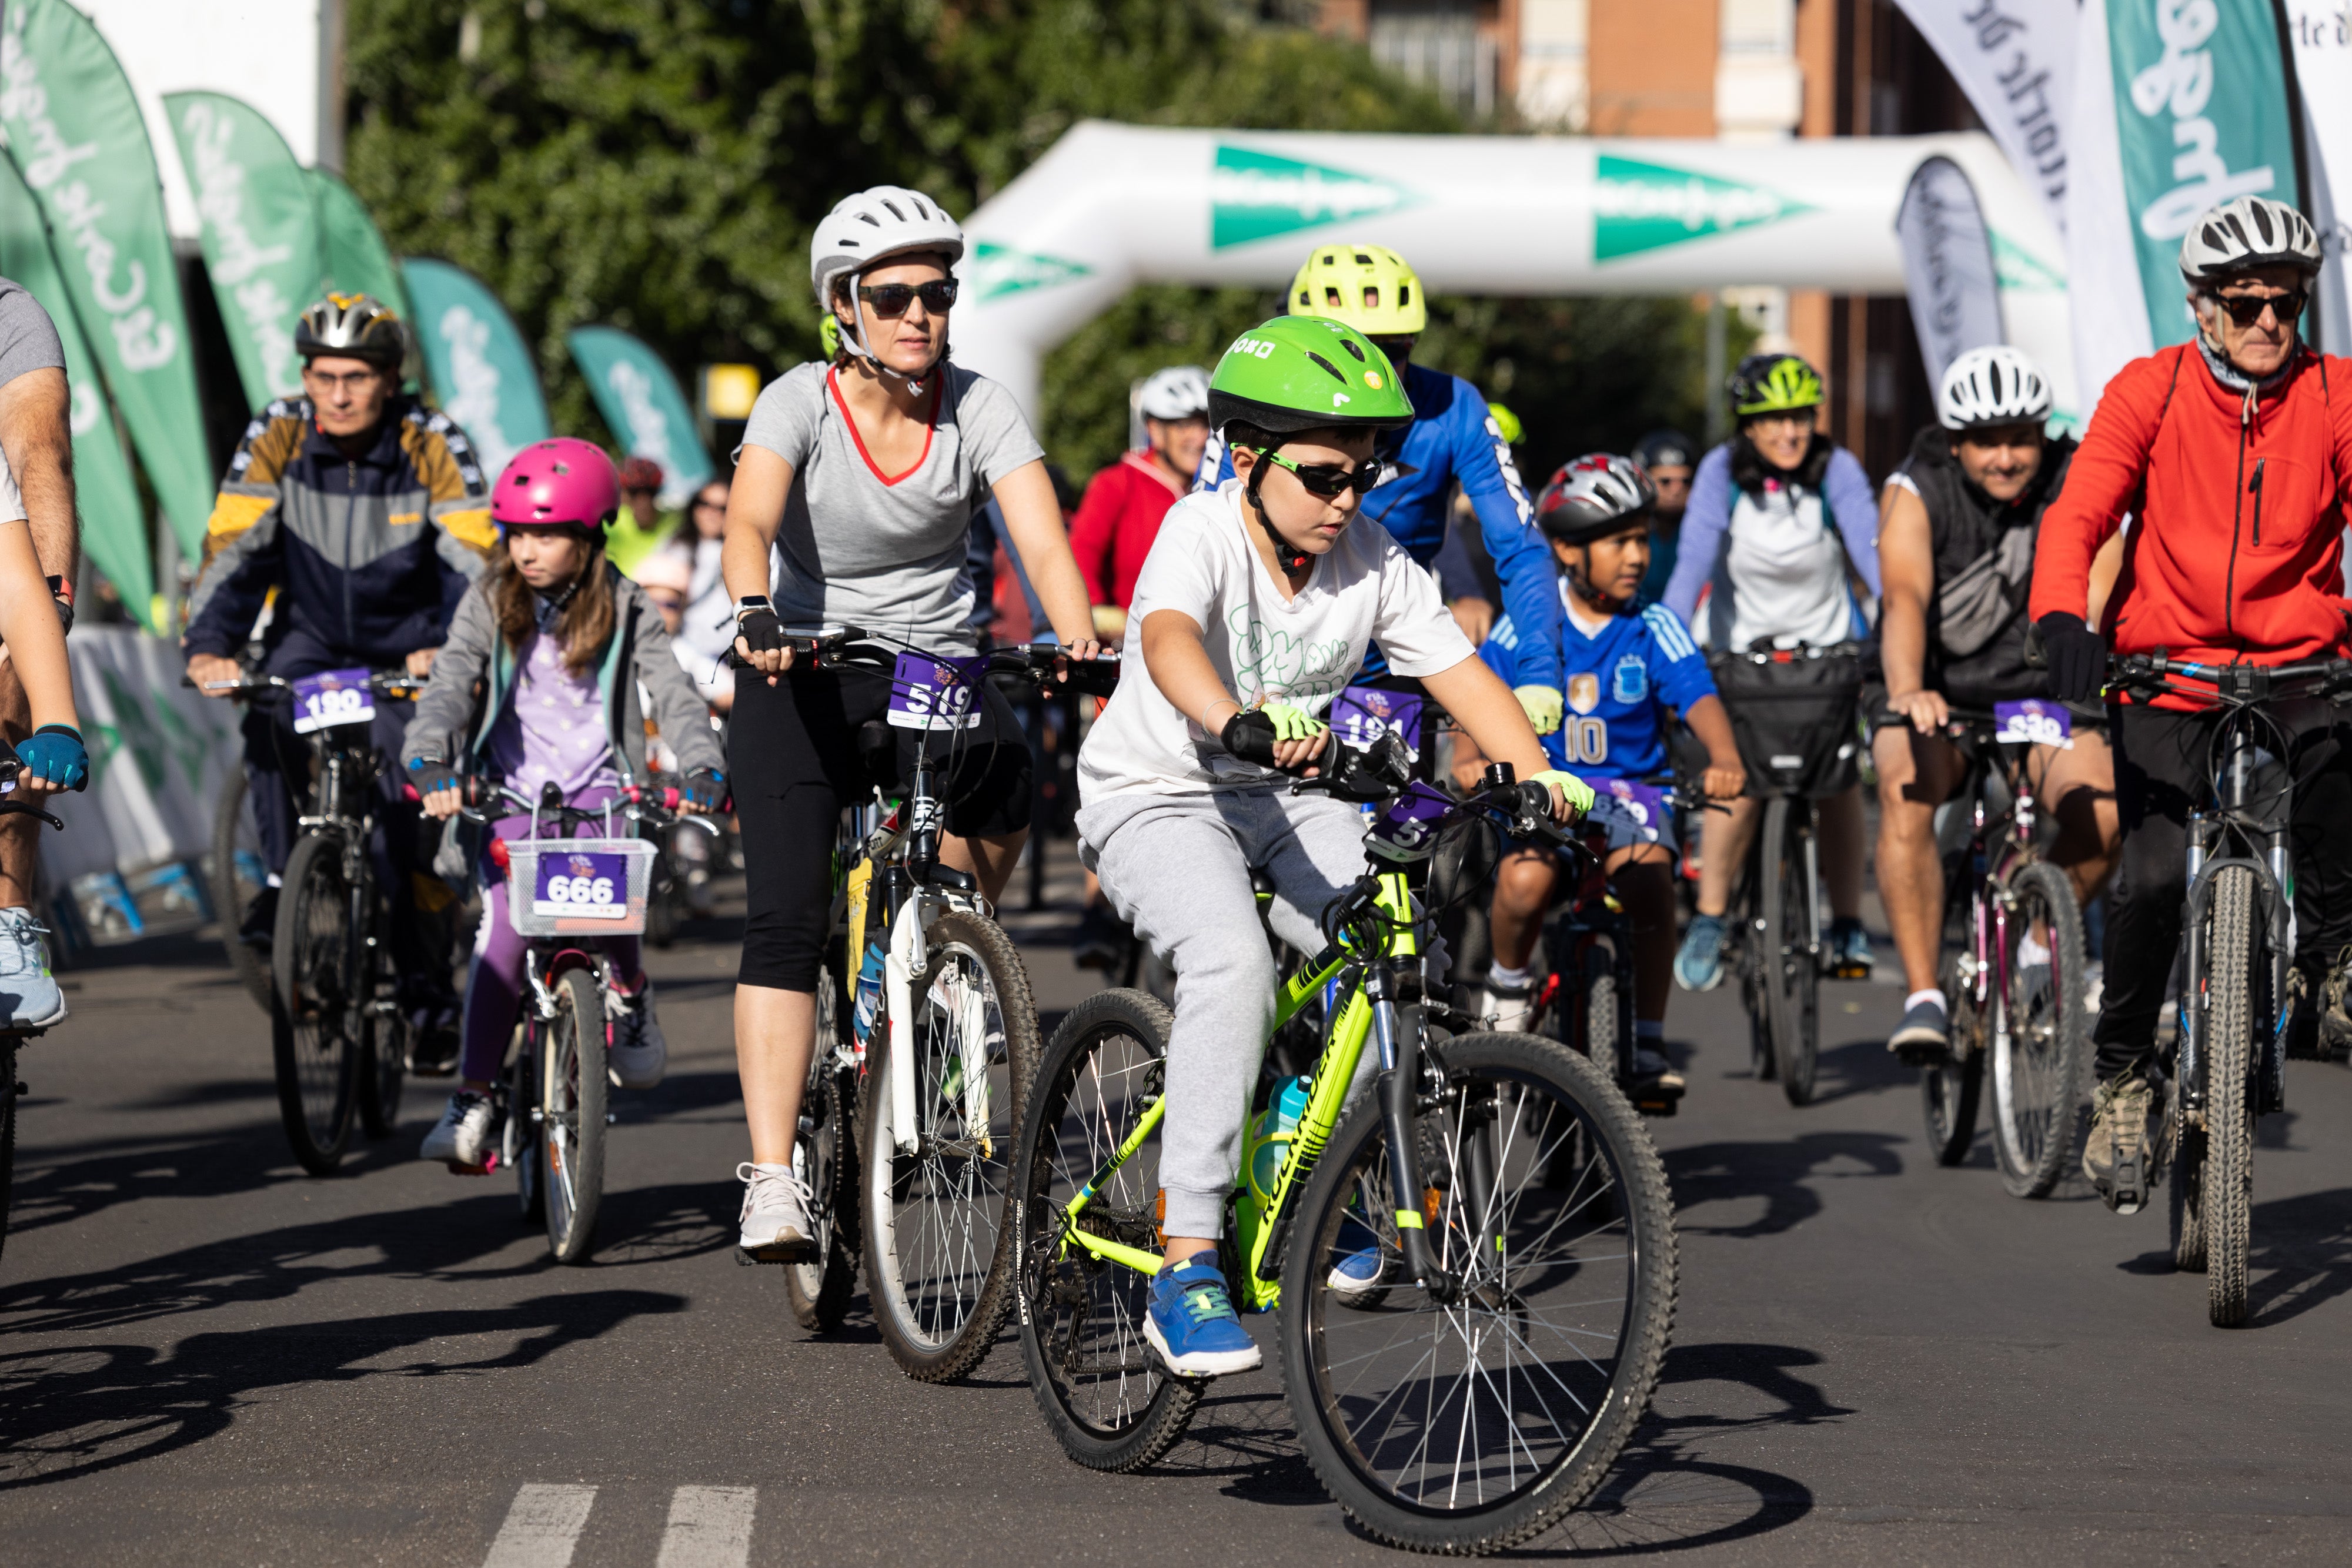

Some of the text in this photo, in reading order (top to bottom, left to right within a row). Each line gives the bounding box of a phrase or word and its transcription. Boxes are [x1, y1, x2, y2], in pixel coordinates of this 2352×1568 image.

[906, 683, 972, 715] 519
[1345, 714, 1403, 741] 191
[1565, 714, 1608, 764] 10
[547, 875, 614, 904] 666
